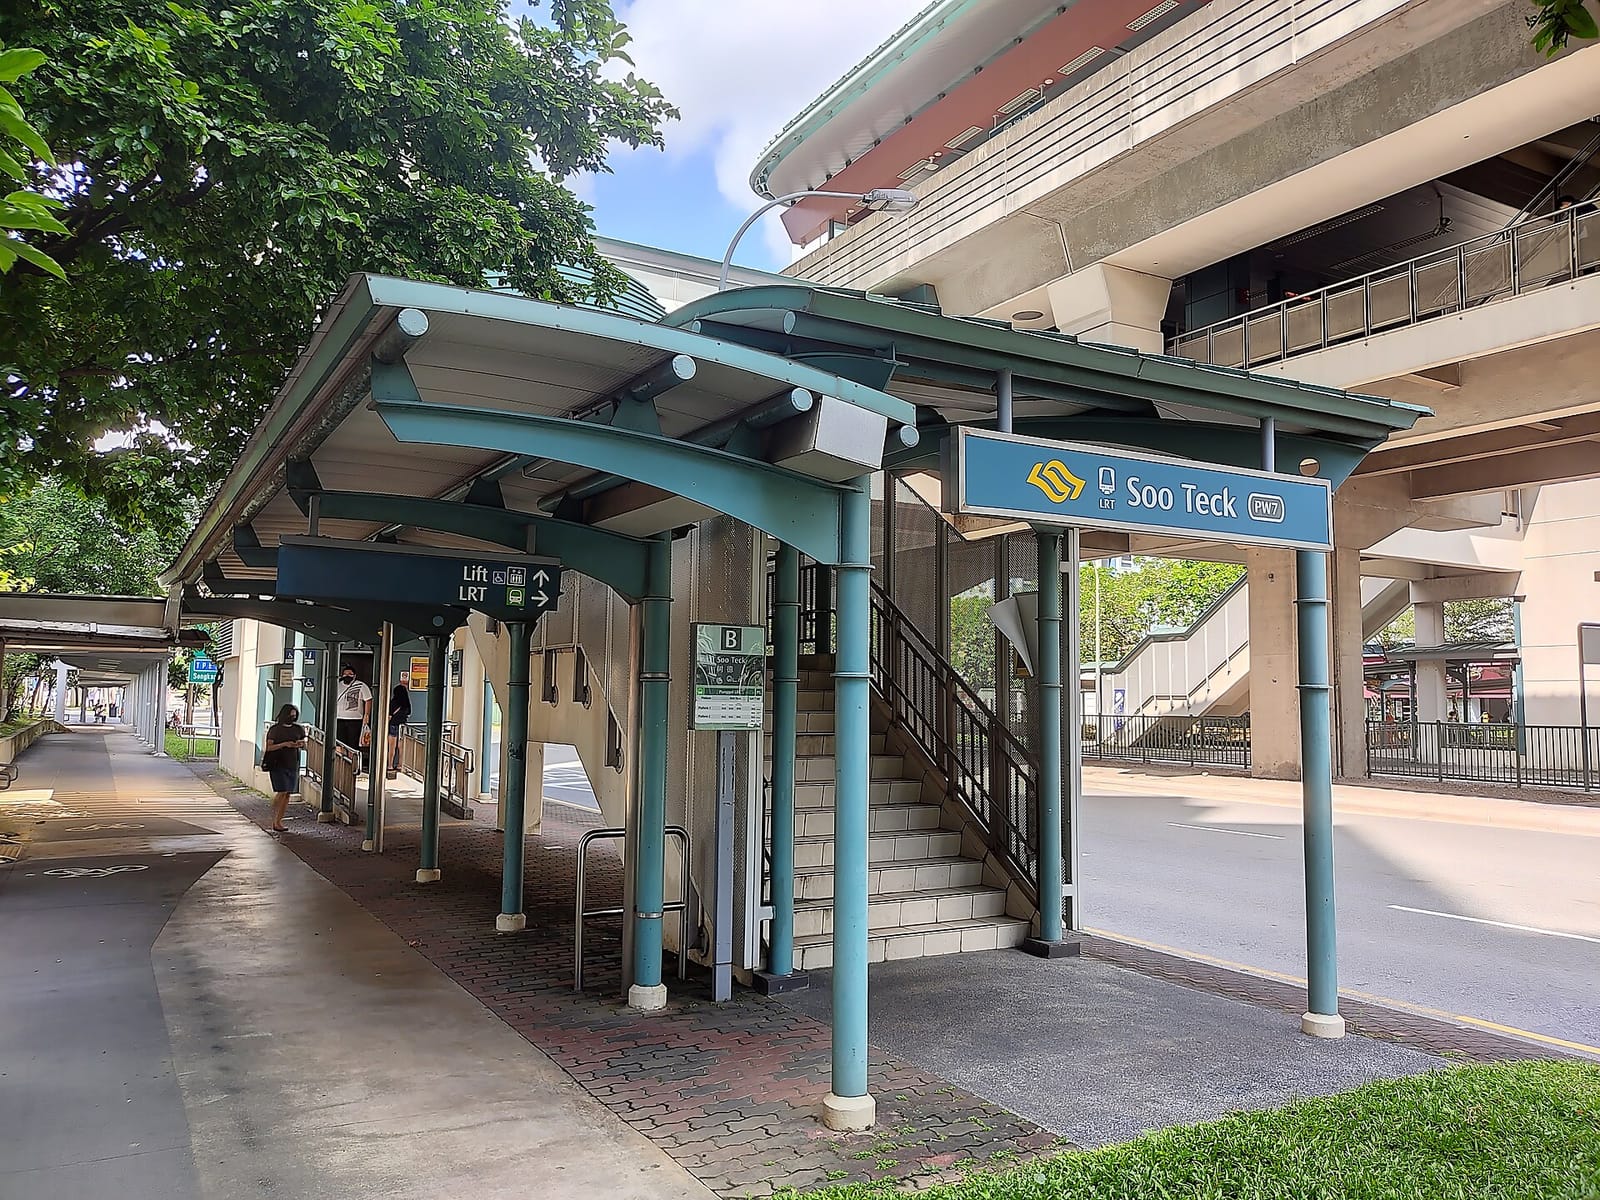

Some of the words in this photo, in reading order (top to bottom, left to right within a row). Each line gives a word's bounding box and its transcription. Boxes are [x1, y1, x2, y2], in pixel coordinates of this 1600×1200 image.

[1099, 498, 1116, 510] LRT
[1126, 475, 1175, 511] Soo
[1180, 483, 1238, 519] Teck
[1253, 500, 1279, 516] PW7
[463, 565, 489, 582] Lift
[459, 585, 488, 602] LRT
[725, 630, 737, 648] B
[716, 655, 730, 664] Soo
[731, 655, 746, 664] Teck
[192, 672, 217, 681] Sengka
